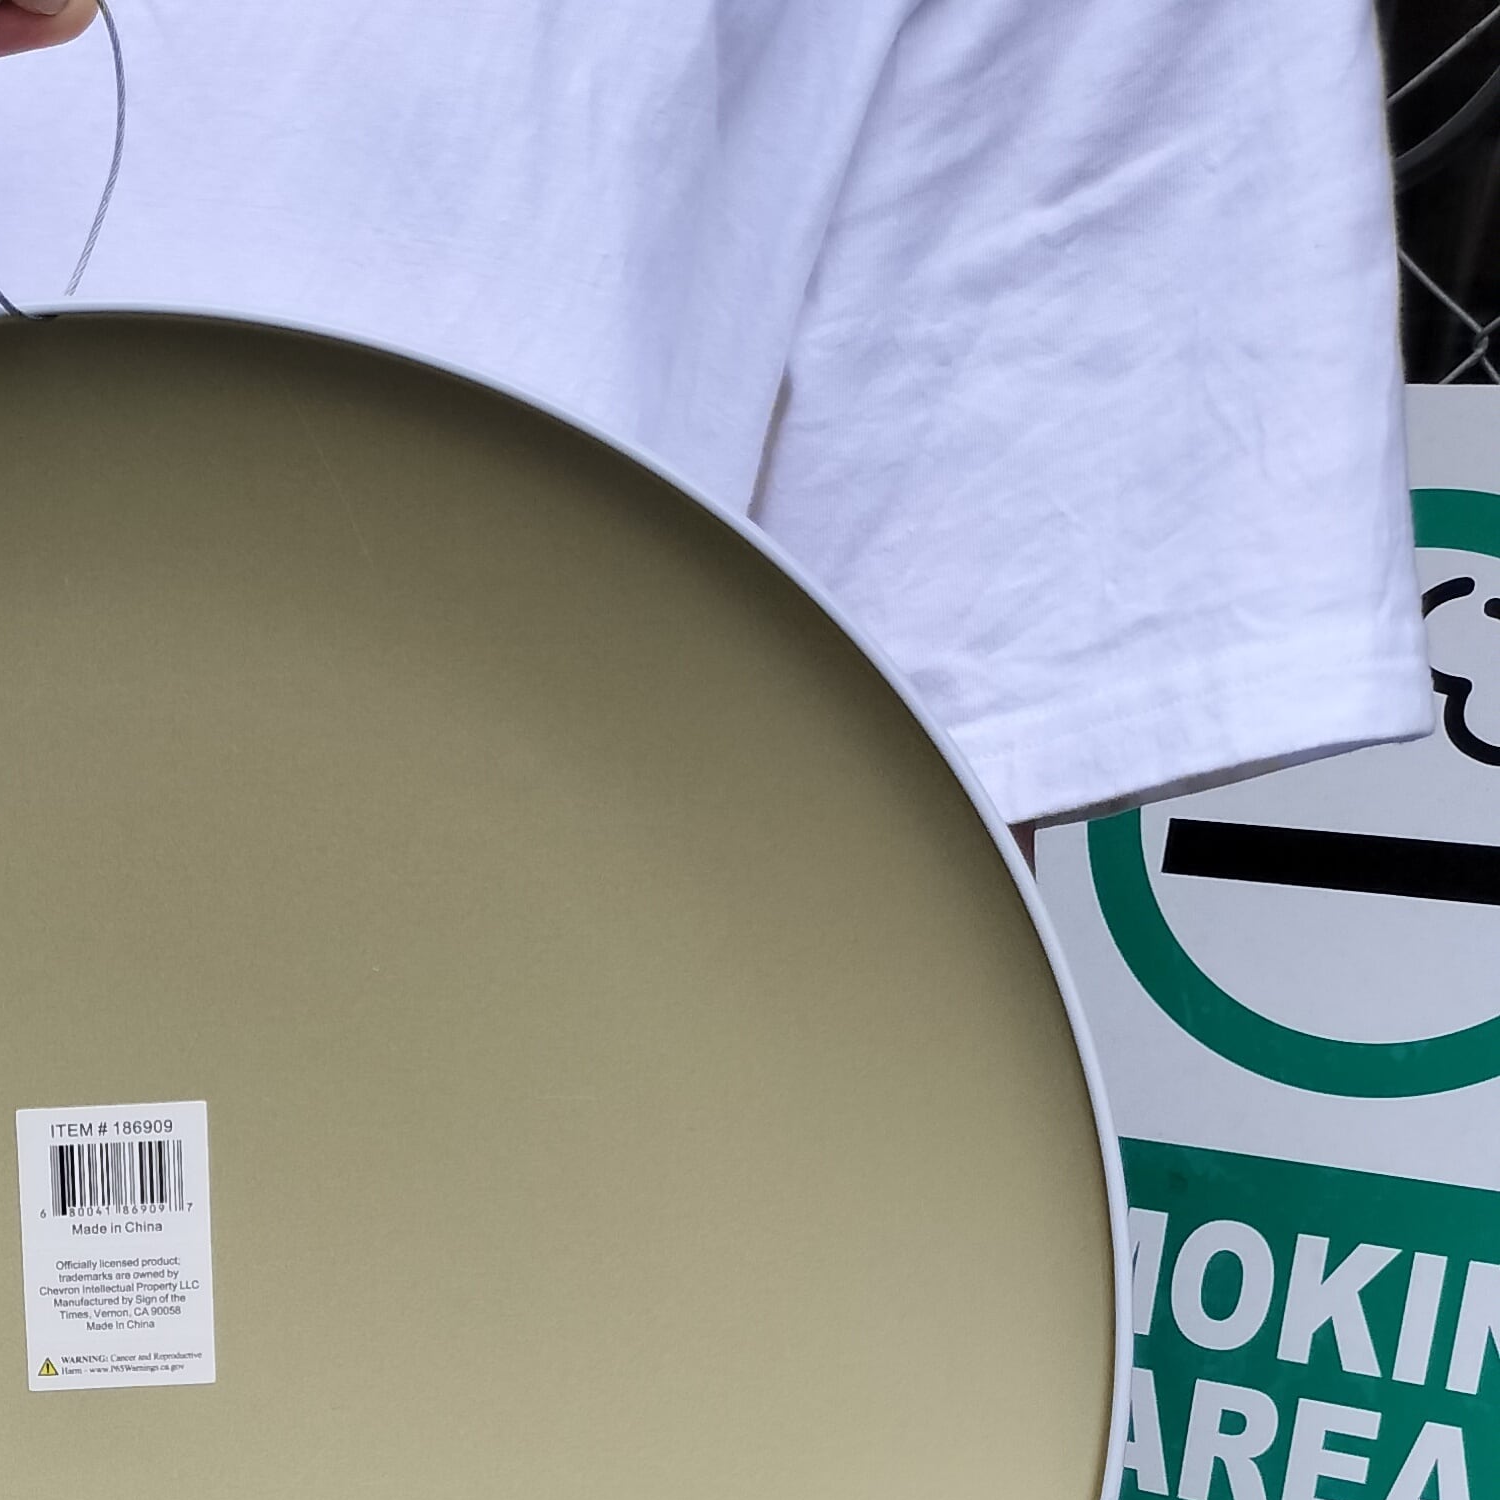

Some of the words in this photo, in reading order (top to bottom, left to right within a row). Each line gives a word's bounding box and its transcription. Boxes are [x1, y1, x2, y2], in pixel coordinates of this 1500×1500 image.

[50, 1122, 93, 1138] ITEM
[98, 1121, 108, 1136] #
[113, 1119, 173, 1135] 186909
[72, 1223, 107, 1235] Made
[110, 1222, 122, 1234] in
[125, 1221, 163, 1232] China
[56, 1260, 97, 1271] Officially
[100, 1258, 139, 1268] licensed
[59, 1272, 113, 1283] trademarks
[116, 1272, 131, 1280] are
[133, 1270, 165, 1279] owned
[167, 1269, 179, 1279] by
[39, 1286, 80, 1296] Chevron
[82, 1283, 134, 1294] Intellectual
[136, 1281, 178, 1293] Property
[180, 1280, 200, 1290] LLC
[54, 1296, 119, 1308] Manufactured
[122, 1296, 133, 1306] by
[135, 1294, 156, 1306] Sign
[159, 1294, 169, 1303] of
[171, 1293, 186, 1302] the
[60, 1310, 92, 1320] Times,
[134, 1307, 149, 1317] CA
[151, 1306, 181, 1316] 90058
[86, 1321, 113, 1331] Made
[127, 1319, 155, 1329] China
[61, 1355, 108, 1364] WARNING:
[110, 1353, 136, 1362] Cancer
[153, 1351, 202, 1361] Reproductive
